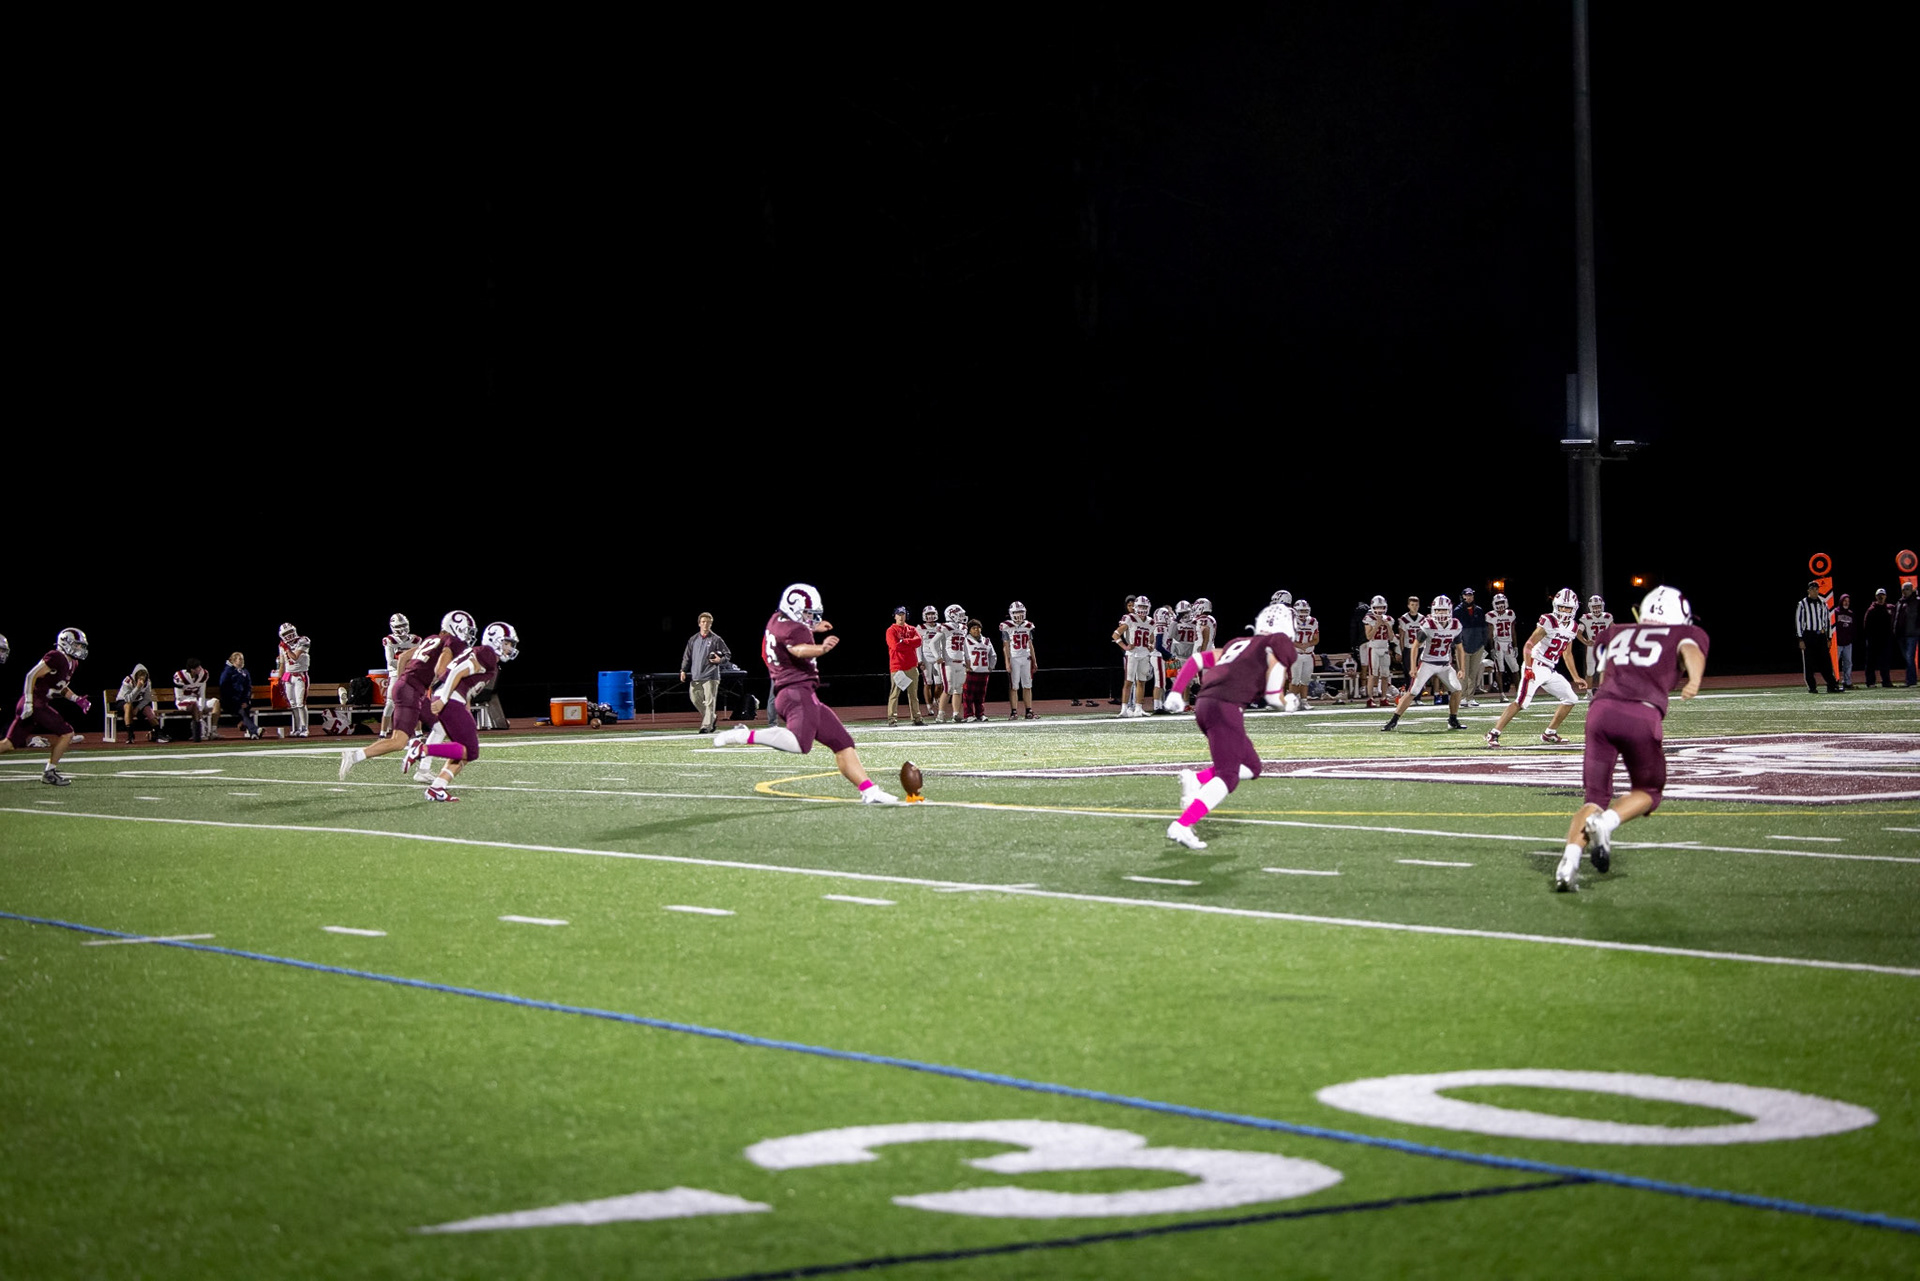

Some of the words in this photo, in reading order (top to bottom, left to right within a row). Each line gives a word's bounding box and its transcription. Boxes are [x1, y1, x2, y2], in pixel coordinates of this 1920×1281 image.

[1134, 629, 1150, 648] 66
[1297, 631, 1313, 644] 77
[1495, 621, 1511, 637] 25
[1013, 634, 1029, 650] 50
[1428, 638, 1453, 657] 23
[1606, 627, 1671, 667] 45
[971, 650, 989, 667] 72
[1214, 639, 1252, 667] 8
[744, 1067, 1879, 1219] 30
